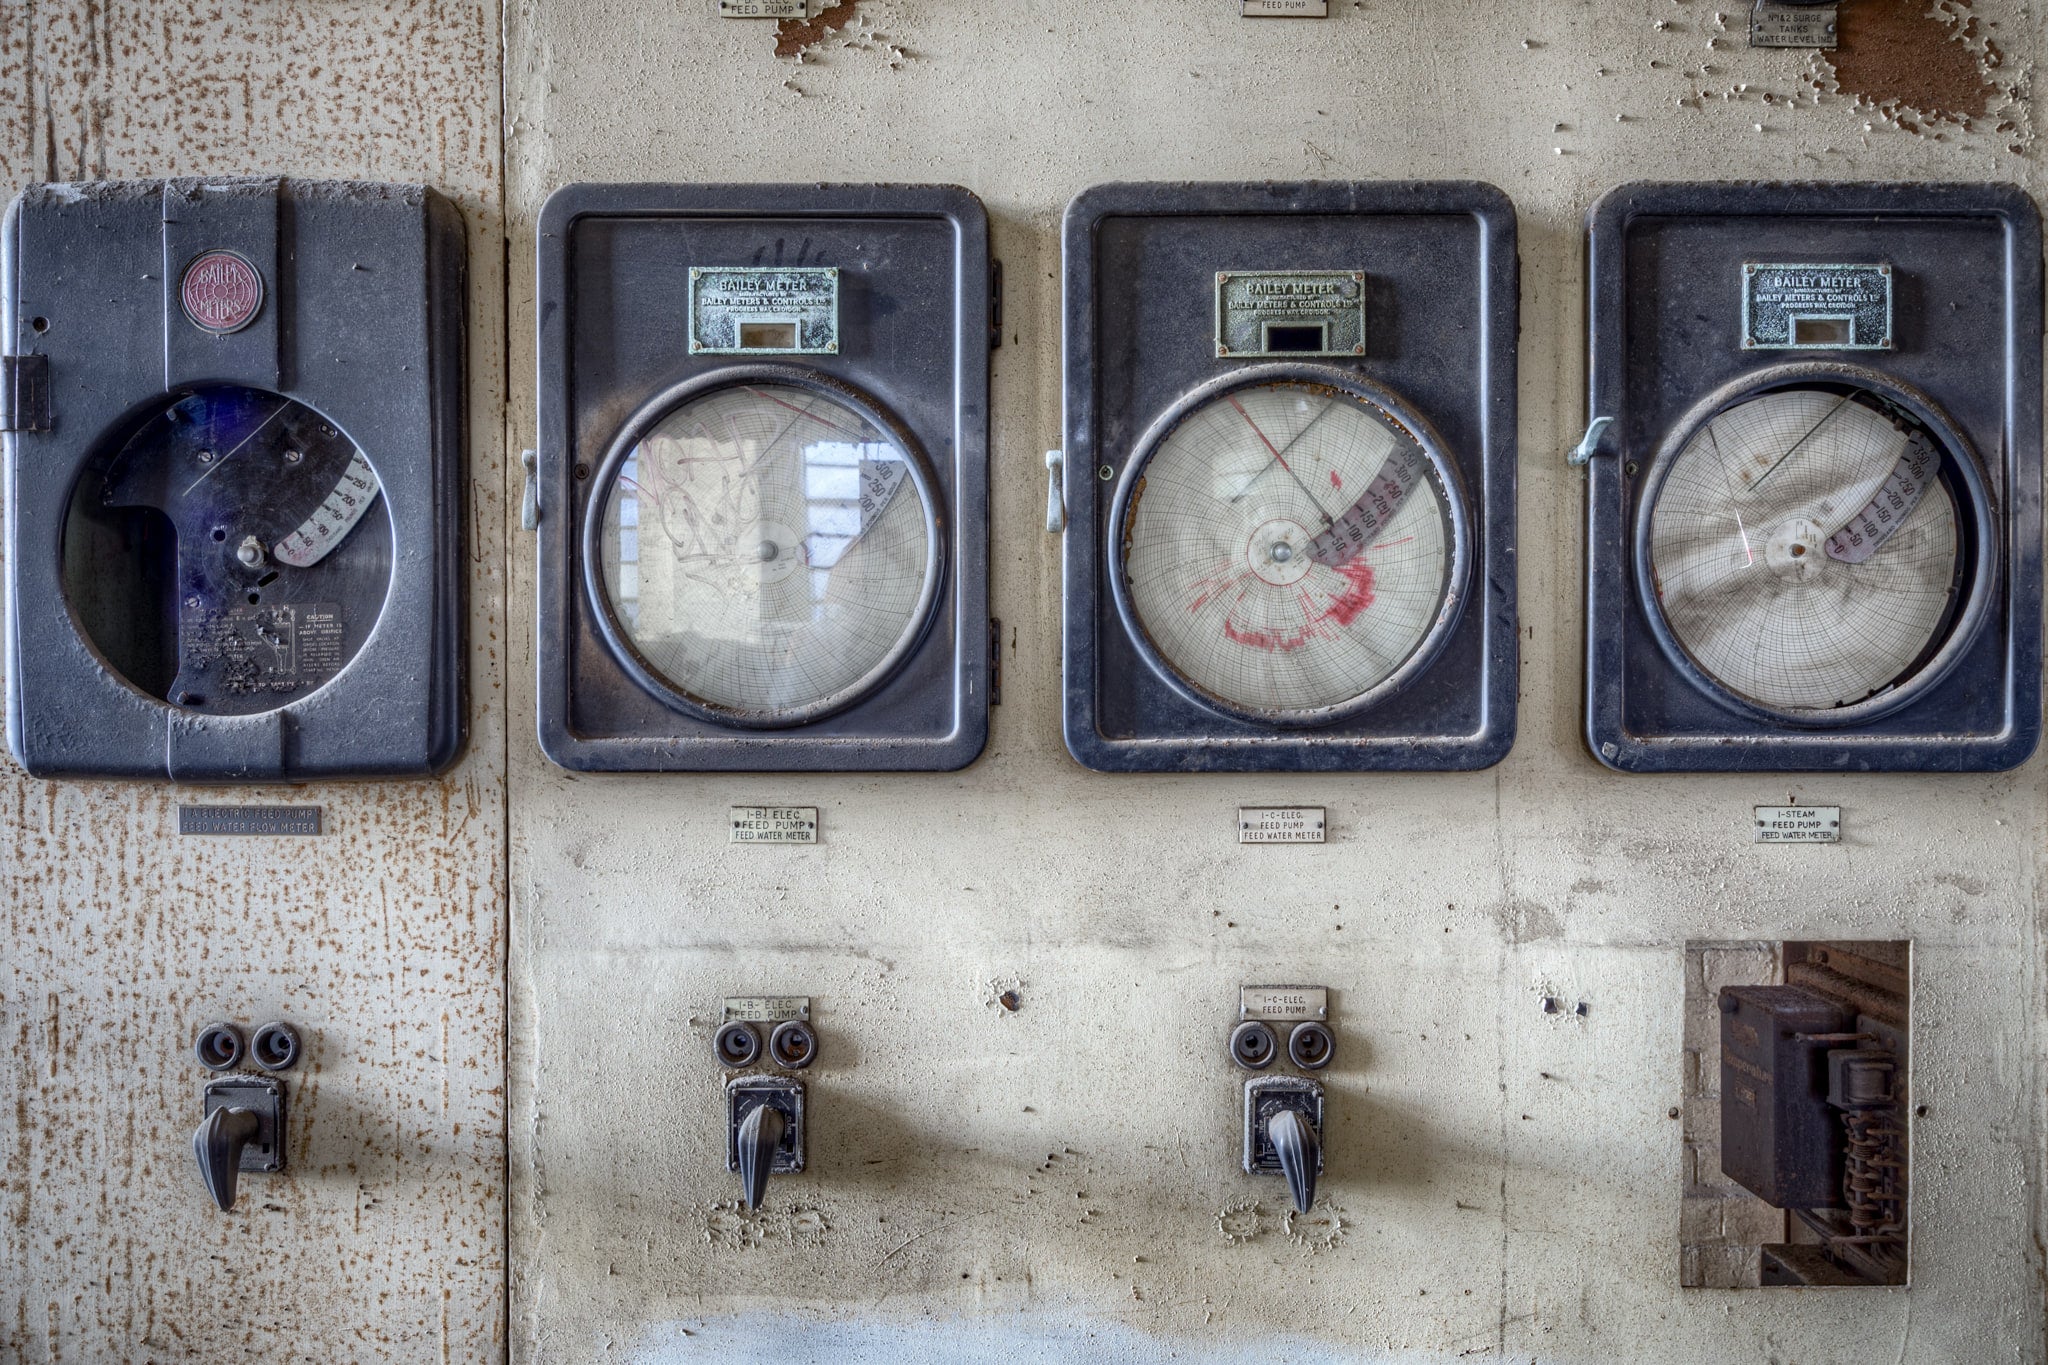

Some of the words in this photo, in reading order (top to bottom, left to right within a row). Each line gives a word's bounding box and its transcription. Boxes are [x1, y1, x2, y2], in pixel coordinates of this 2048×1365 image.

[731, 5, 758, 14] FEED
[765, 5, 794, 14] PUMP
[1262, 1, 1282, 9] FEED
[1285, 1, 1306, 9] PUMP
[1793, 14, 1821, 22] SURGE
[1779, 25, 1808, 33] TANKS
[1758, 35, 1786, 43] WATER
[1788, 35, 1816, 43] LEVEL
[720, 280, 761, 291] BAILEY
[766, 280, 807, 291] METER
[1774, 276, 1816, 288] BAILEY
[1820, 277, 1861, 287] METER
[1246, 284, 1288, 295] BAILEY
[1293, 284, 1334, 294] METER
[702, 297, 728, 306] BAILEY
[730, 297, 760, 306] METERS
[772, 297, 813, 305] CONTROLS
[1756, 294, 1782, 302] BAILEY
[1785, 294, 1815, 302] METERS
[1827, 294, 1867, 302] CONTROLS
[200, 298, 241, 319] METERS
[1228, 301, 1254, 310] BAILEY
[1257, 301, 1288, 309] METERS
[1299, 300, 1342, 309] CONTROLS
[1913, 447, 1930, 465] 350
[1394, 465, 1411, 483] 300
[1907, 461, 1925, 480] 300
[352, 477, 367, 490] 250
[868, 478, 886, 497] 250
[1899, 478, 1915, 496] 250
[1384, 480, 1402, 499] 250
[342, 494, 355, 507] 200
[1372, 495, 1390, 515] 200
[1887, 491, 1905, 510] 200
[1360, 511, 1377, 529] 150
[1875, 506, 1891, 523] 150
[1347, 525, 1364, 542] 100
[1863, 521, 1879, 538] 100
[303, 536, 314, 547] 50
[1332, 538, 1346, 551] 50
[1850, 532, 1863, 547] 50
[1317, 548, 1328, 557] 0
[1834, 544, 1845, 554] 0
[200, 808, 250, 818] ELECTRIC
[254, 809, 281, 819] FEED
[285, 809, 312, 819] PUMP
[182, 822, 208, 832] FEED
[212, 822, 246, 833] WATER
[249, 822, 276, 833] FLOW
[280, 822, 315, 833] METER
[742, 821, 769, 830] FEED
[775, 821, 805, 830] PUMP
[1260, 821, 1280, 829] FEED
[1283, 821, 1304, 829] PUMP
[1772, 821, 1795, 829] FEED
[1797, 821, 1821, 829] PUMP
[735, 831, 754, 840] FEED
[757, 831, 782, 840] WATER
[785, 831, 811, 840] METER
[1244, 831, 1264, 840] FEED
[1267, 831, 1292, 840] WATER
[1295, 831, 1321, 839] METER
[1761, 831, 1780, 839] FEED
[1782, 831, 1807, 839] WATER
[1808, 831, 1832, 839] METER
[734, 1010, 761, 1019] FEED
[767, 1010, 797, 1019] PUMP
[1262, 1005, 1282, 1014] FEED
[1285, 1005, 1307, 1014] PUMP
